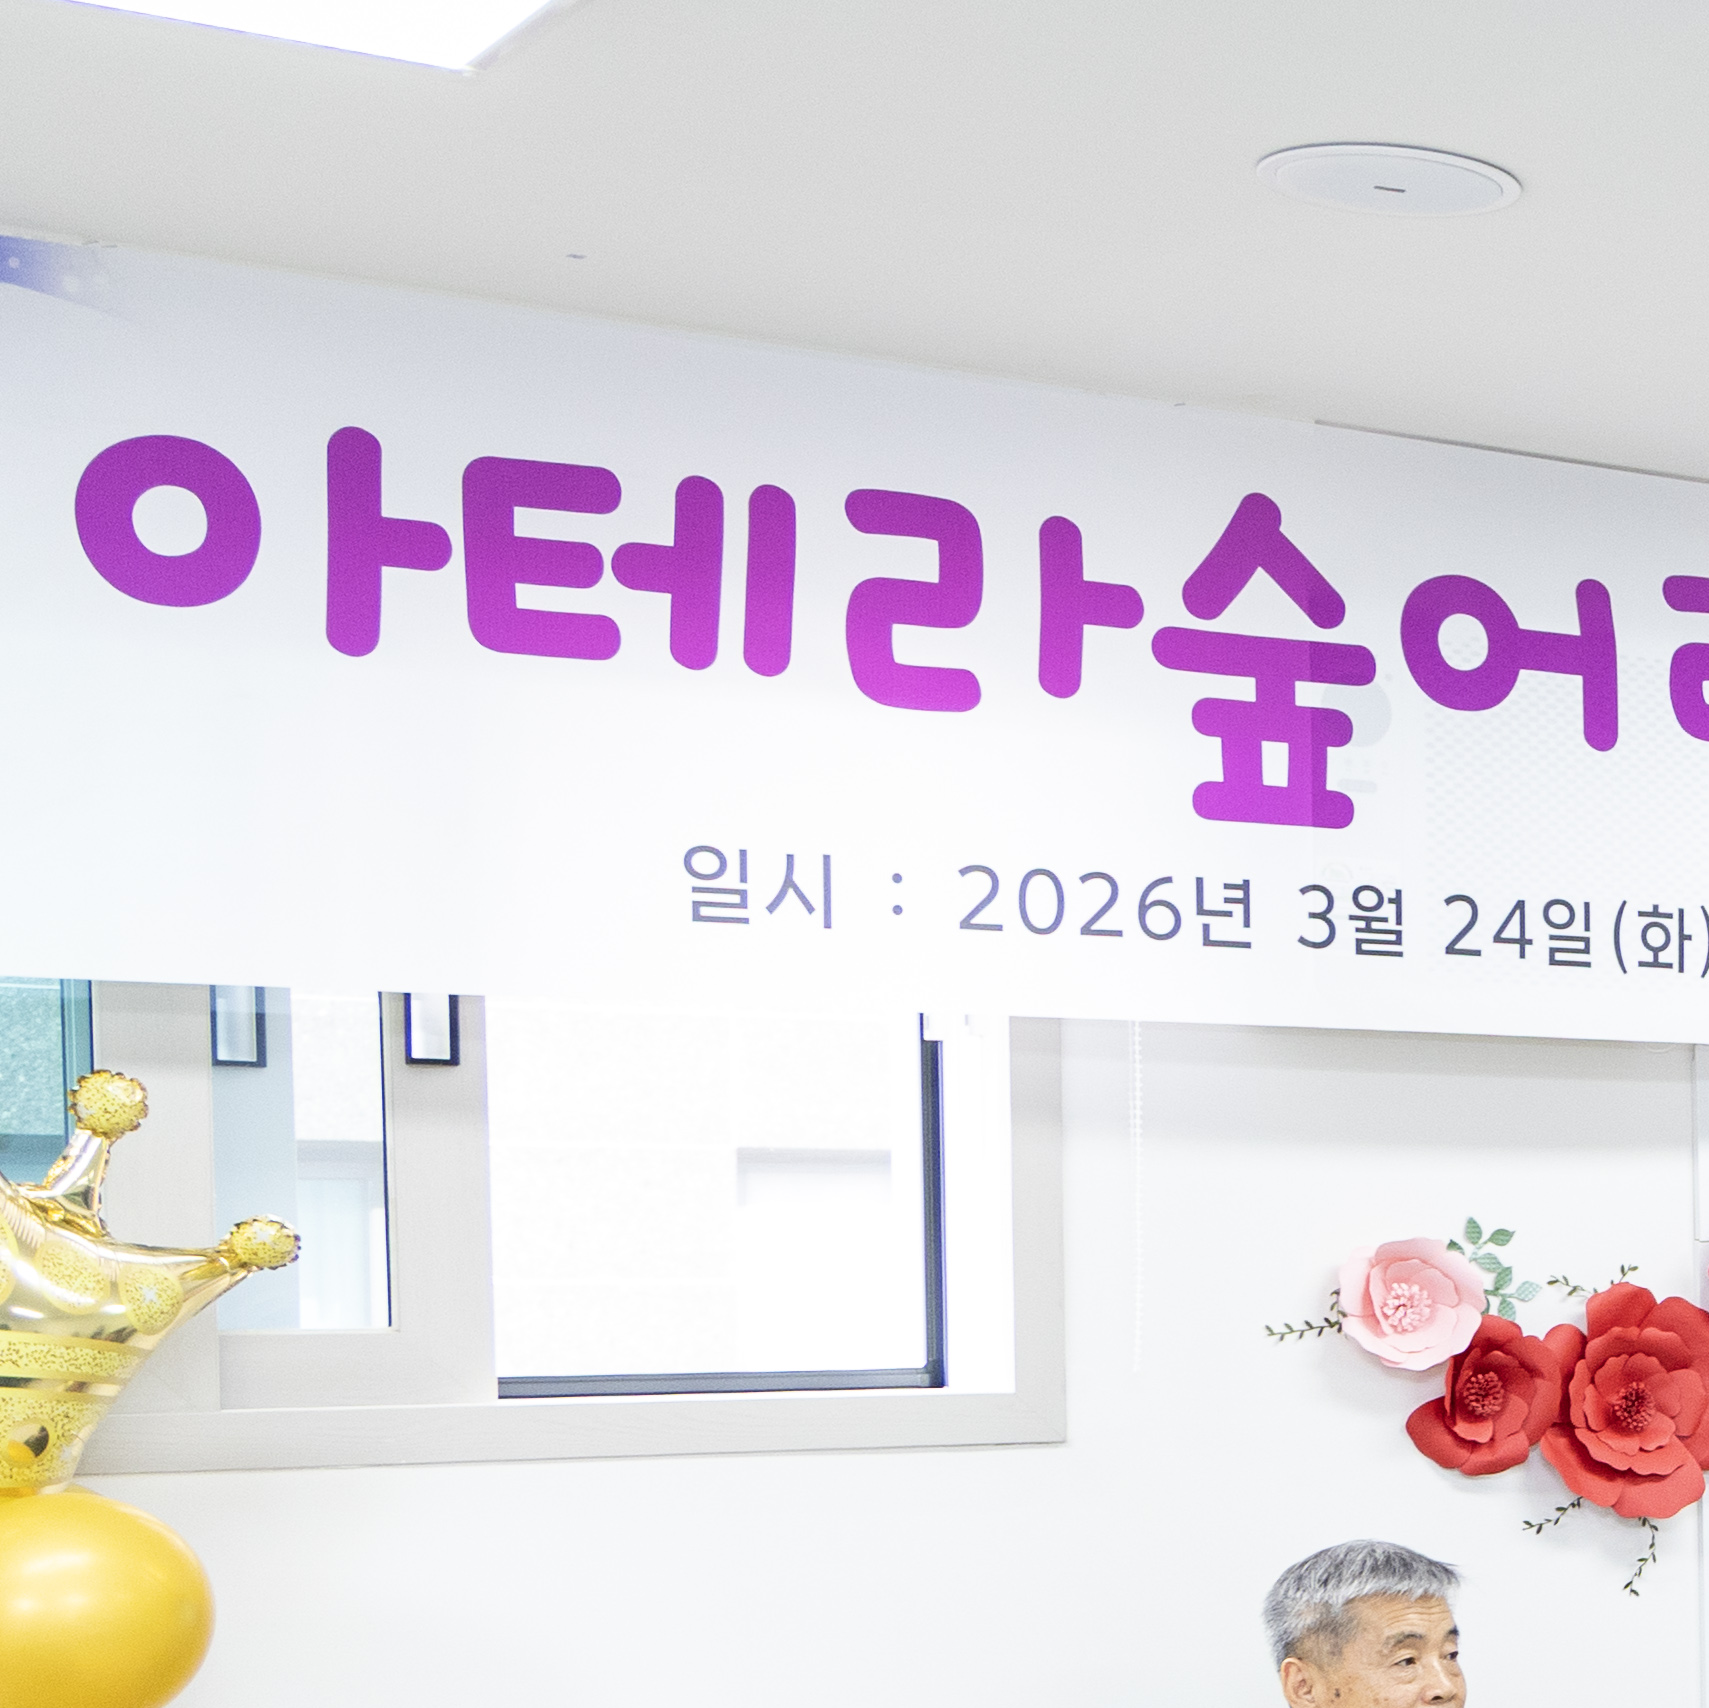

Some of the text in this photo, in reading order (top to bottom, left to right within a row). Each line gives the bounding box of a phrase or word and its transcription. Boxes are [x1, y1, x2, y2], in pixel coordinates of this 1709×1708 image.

[682, 845, 832, 929] 일시
[891, 872, 904, 917] :
[957, 863, 1253, 950] 2026년
[1297, 883, 1404, 958] 3월
